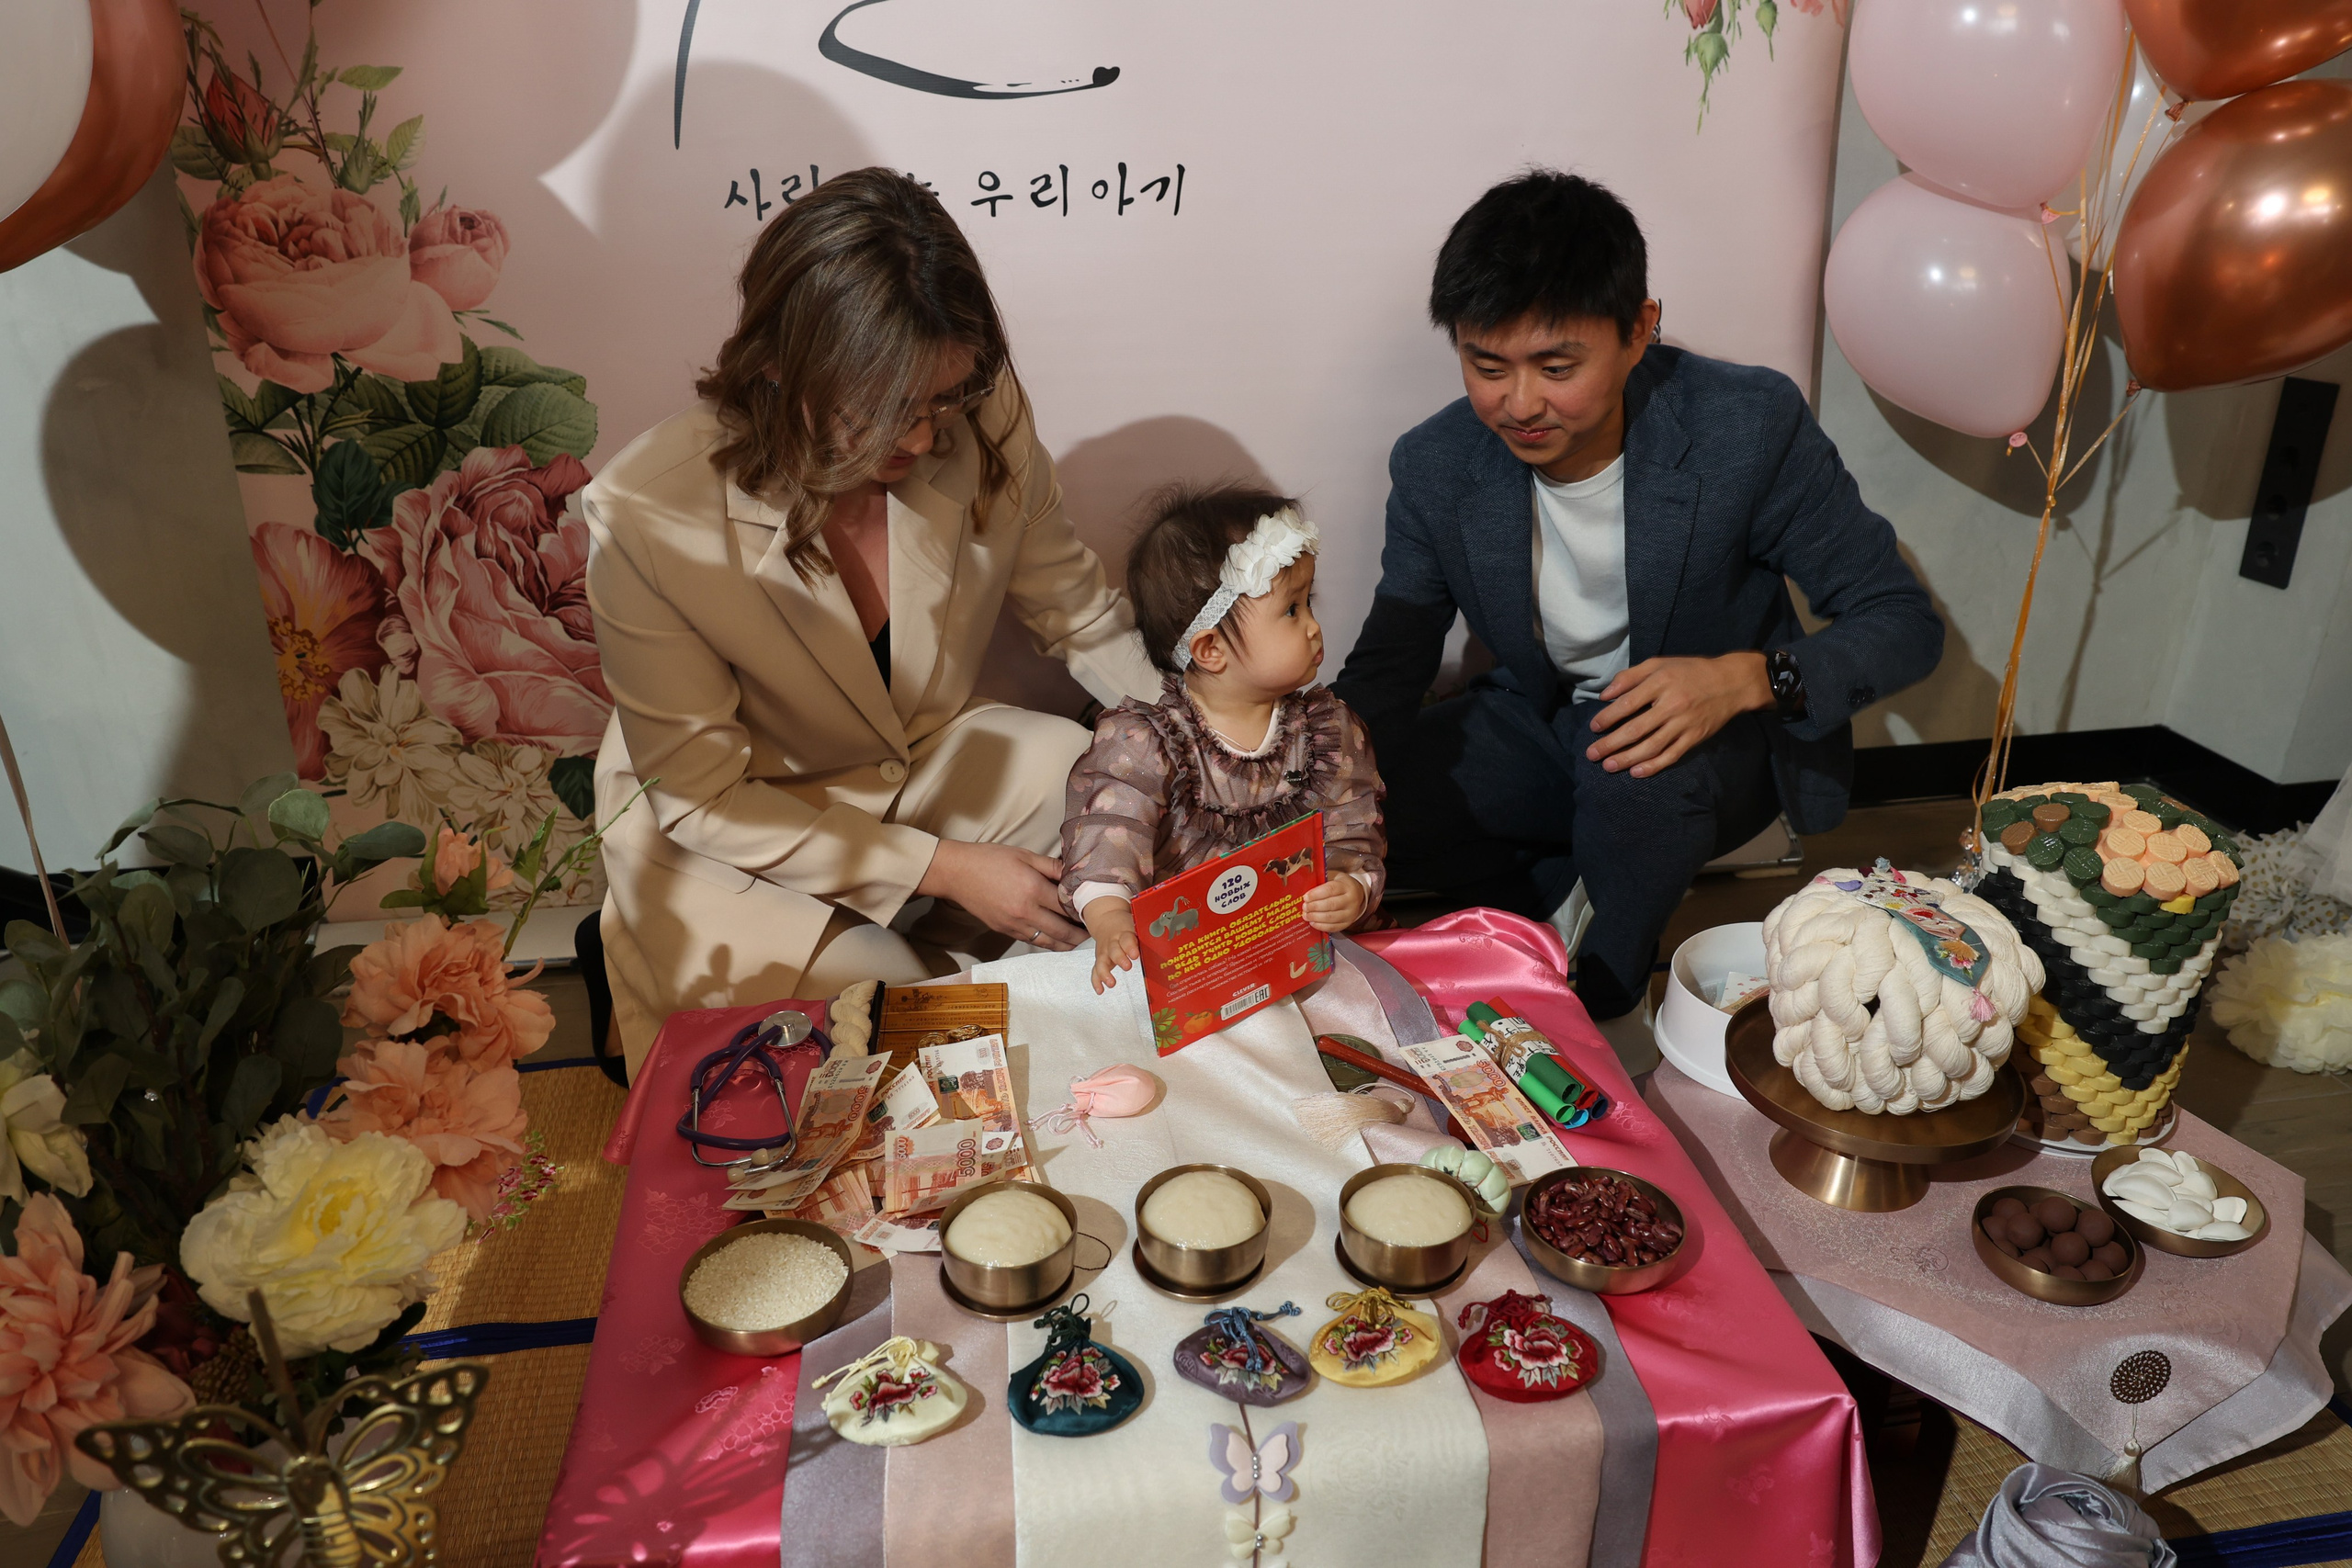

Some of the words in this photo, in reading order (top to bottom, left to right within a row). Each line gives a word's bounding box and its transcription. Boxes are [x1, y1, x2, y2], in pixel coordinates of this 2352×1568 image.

[970, 163, 1069, 218] 우리
[1091, 161, 1186, 217] 아기
[1215, 881, 1250, 902] НОВЫХ
[1222, 874, 1242, 889] 120
[1221, 893, 1246, 908] СЛОВ
[1159, 936, 1222, 969] ПОНРАВИТСЯ
[1224, 915, 1263, 940] ВАШЕМУ
[1266, 896, 1305, 919] МАЛЫШ
[1174, 955, 1199, 970] ВЕДЬ
[1202, 939, 1233, 957] УЧИТЬ
[1235, 921, 1267, 942] НОВЫЕ
[1268, 907, 1297, 924] СЛОВА
[1178, 942, 1195, 953] ЭТА
[1197, 926, 1227, 943] КНИГА
[1229, 895, 1292, 929] ОБЯЗАТЕЛЬНО
[1167, 971, 1182, 981] ПО
[1183, 960, 1202, 974] НЕЙ
[1204, 948, 1230, 964] ОДНО
[1232, 983, 1255, 997] CLEVER
[881, 1073, 907, 1098] РОССИИ
[1476, 1059, 1506, 1087] 5000
[847, 1085, 871, 1122] 5000
[898, 1137, 908, 1160] 5000
[1531, 1115, 1548, 1134] БАНКА
[1546, 1135, 1569, 1161] РОССИИ
[956, 1139, 976, 1177] 5000
